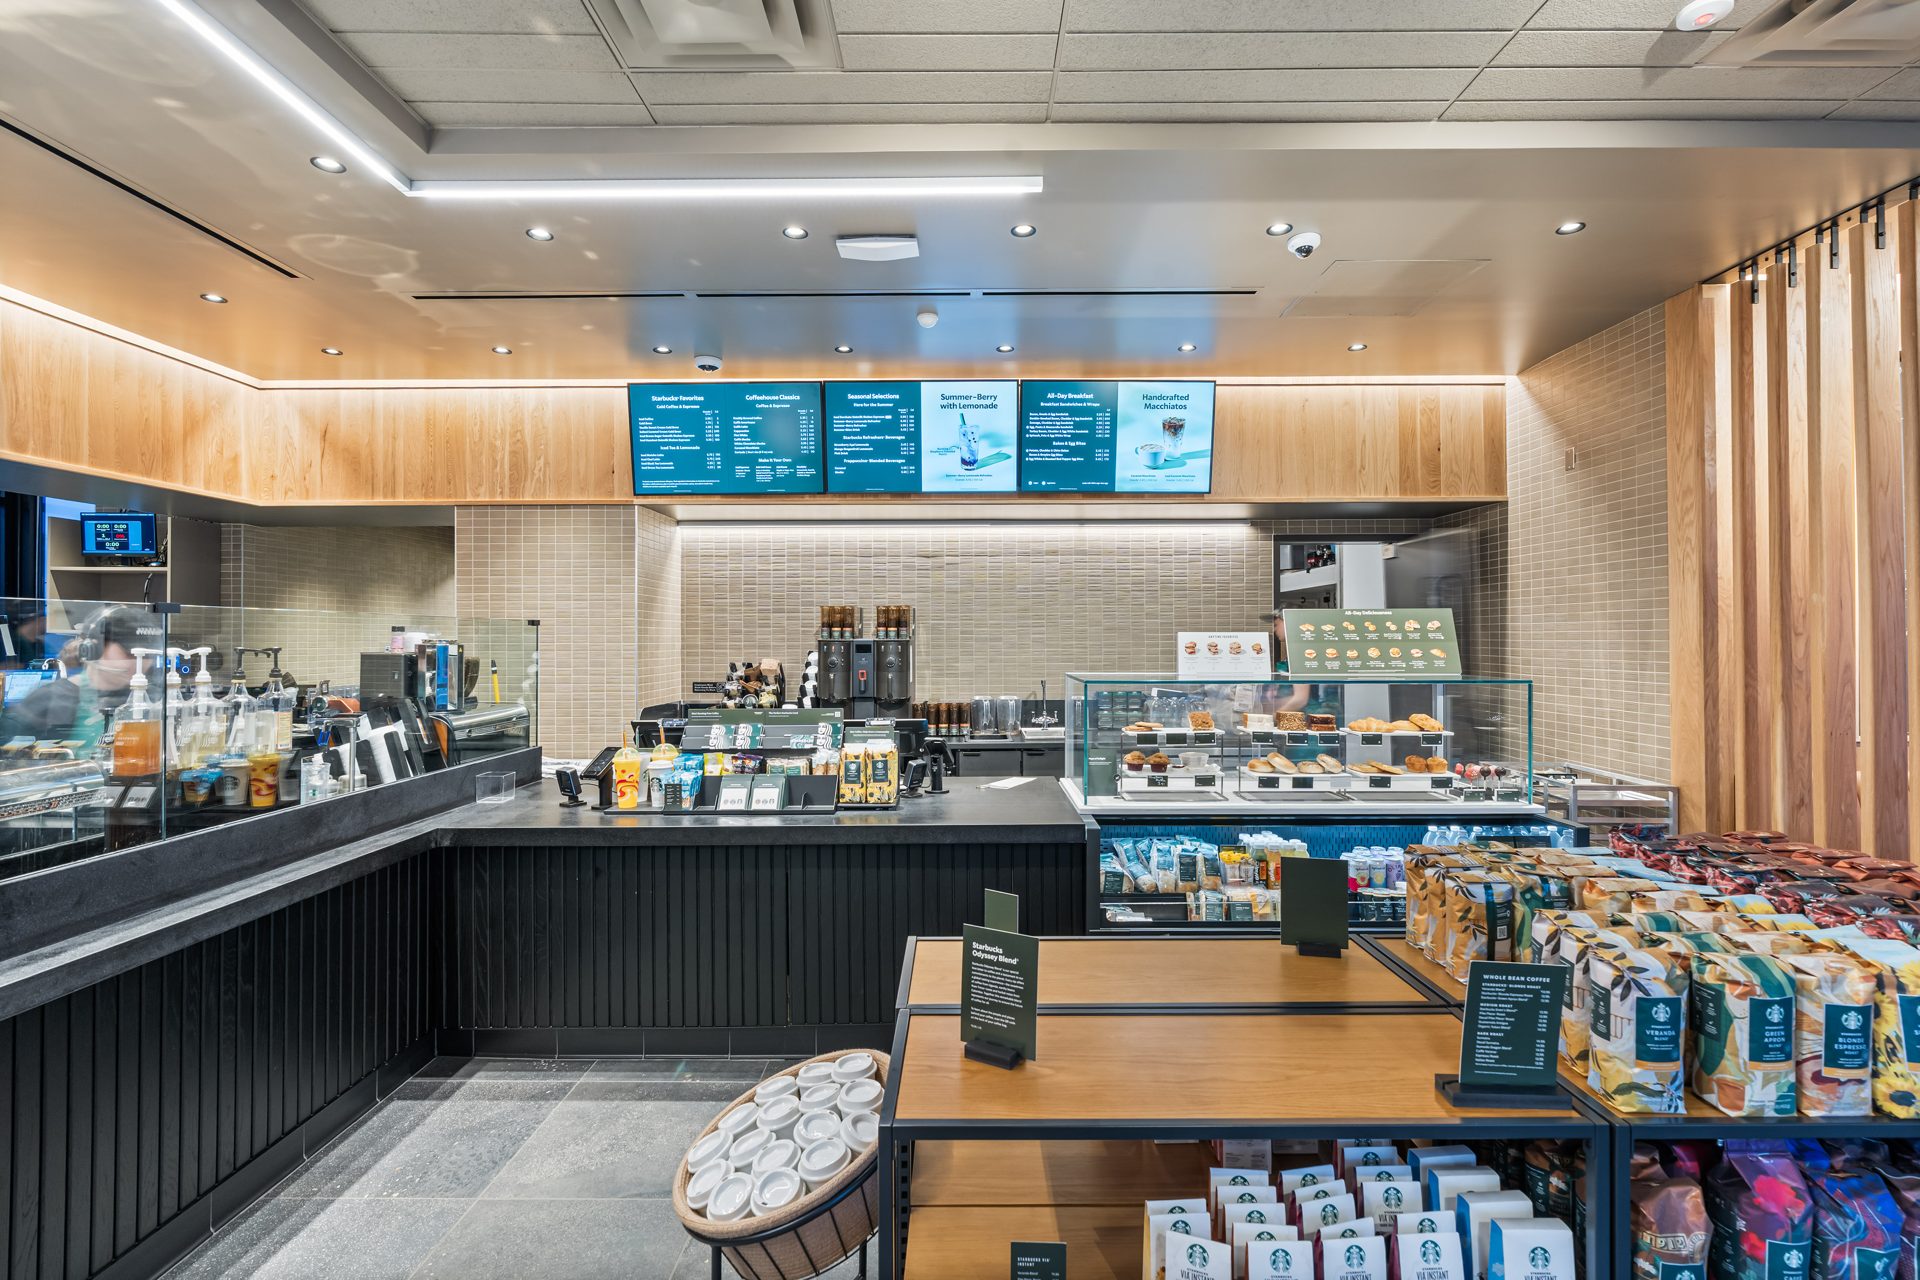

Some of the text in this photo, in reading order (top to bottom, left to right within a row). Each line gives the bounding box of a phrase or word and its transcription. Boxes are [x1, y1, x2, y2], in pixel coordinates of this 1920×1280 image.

[972, 941, 1003, 954] Starbucks
[972, 950, 1000, 962] Odyssey
[1181, 1270, 1214, 1280] VIA INSTANT
[1416, 1271, 1448, 1280] VIA INSTANT
